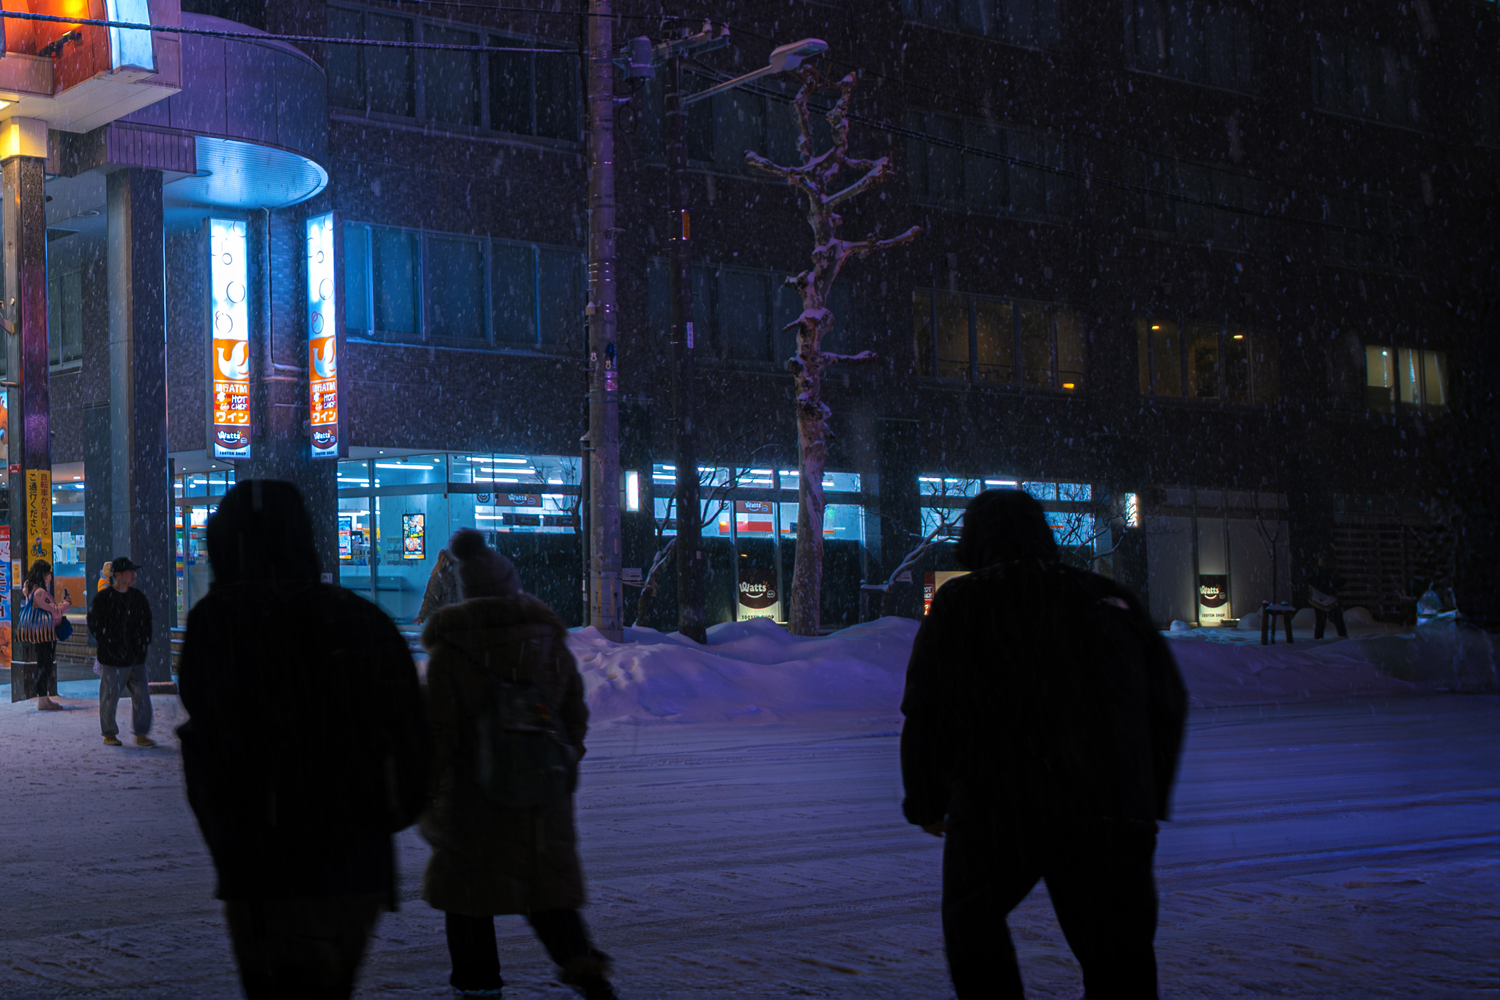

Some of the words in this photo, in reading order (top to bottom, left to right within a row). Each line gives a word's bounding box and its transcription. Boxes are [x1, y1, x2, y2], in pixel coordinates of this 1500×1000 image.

[232, 395, 248, 403] HOT
[324, 393, 336, 402] HOT
[216, 412, 248, 423] ワイン
[312, 411, 336, 423] ワイン
[217, 430, 241, 440] Watts
[739, 581, 767, 592] Watts
[1199, 585, 1220, 594] Watts
